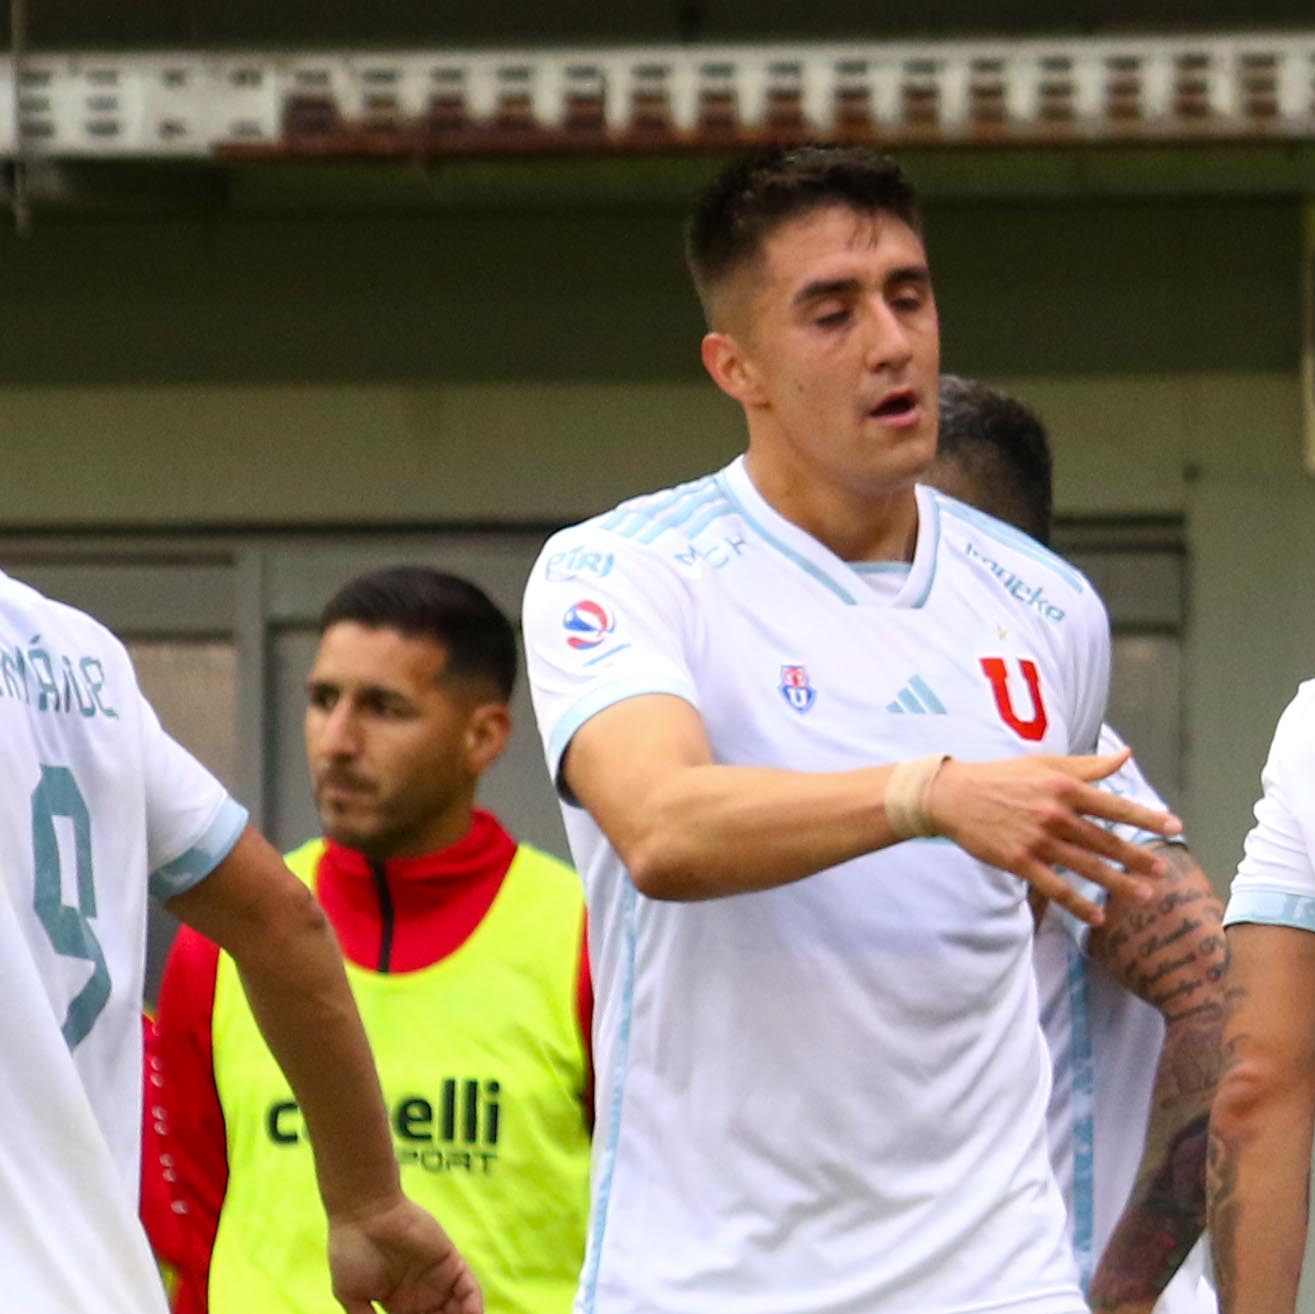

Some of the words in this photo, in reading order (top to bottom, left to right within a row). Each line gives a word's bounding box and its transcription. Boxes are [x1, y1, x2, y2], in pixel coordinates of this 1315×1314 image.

[980, 658, 1047, 741] U
[31, 763, 112, 1051] 9
[267, 1079, 500, 1144] celli
[399, 1151, 499, 1173] PORT
